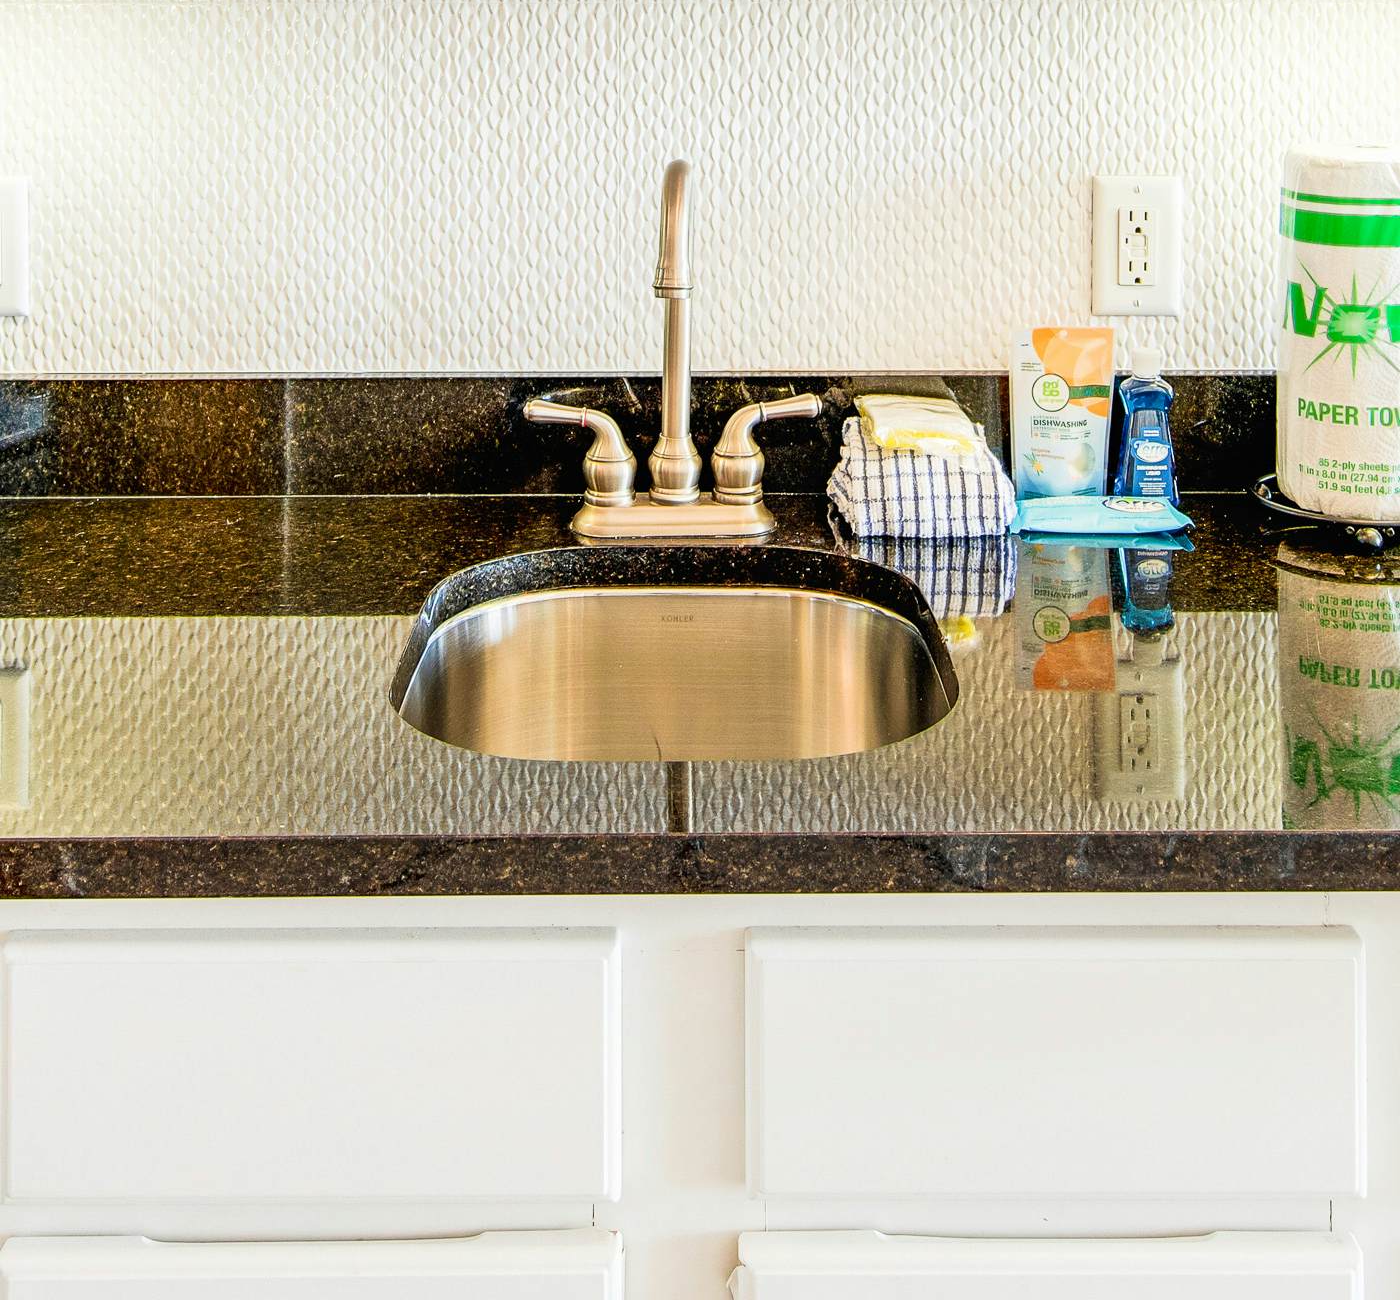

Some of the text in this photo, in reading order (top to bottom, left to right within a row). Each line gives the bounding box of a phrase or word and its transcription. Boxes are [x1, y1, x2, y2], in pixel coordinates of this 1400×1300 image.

[1297, 397, 1359, 426] PAPER
[1033, 419, 1088, 429] DISHWASHING
[1332, 460, 1356, 471] 2-ply
[1358, 462, 1389, 472] sheets
[1322, 470, 1337, 480] 8.0
[1338, 472, 1348, 480] in
[1350, 473, 1379, 483] (27.94
[1318, 481, 1338, 491] 51.9
[1340, 485, 1352, 495] sq
[1354, 484, 1373, 494] feet
